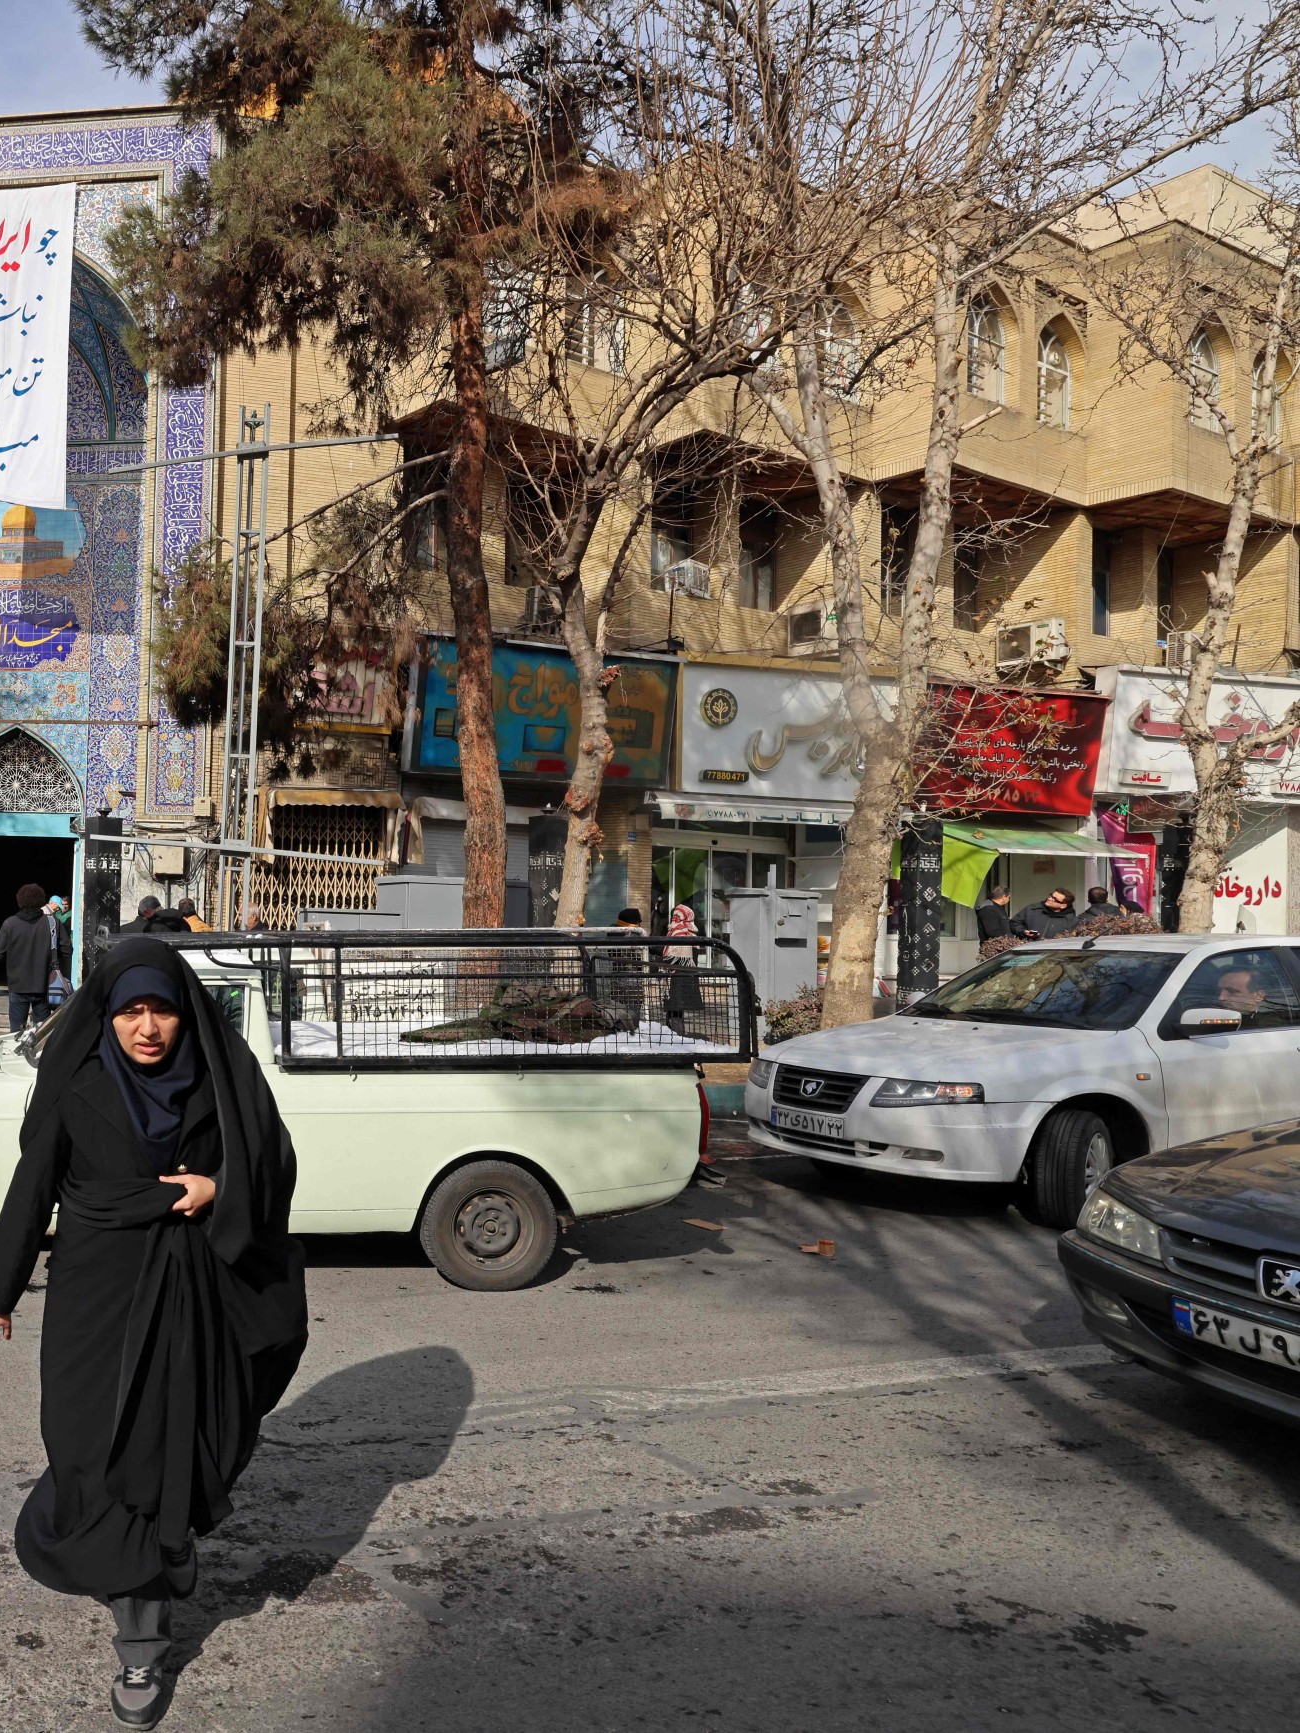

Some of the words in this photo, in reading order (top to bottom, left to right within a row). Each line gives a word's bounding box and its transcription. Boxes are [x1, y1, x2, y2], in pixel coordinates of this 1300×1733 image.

[35, 228, 60, 266] چو
[706, 771, 745, 782] 77880471
[1131, 771, 1162, 784] عافیت
[1214, 875, 1282, 906] داروخان
[1193, 1310, 1300, 1366] ۶۳ل۹
